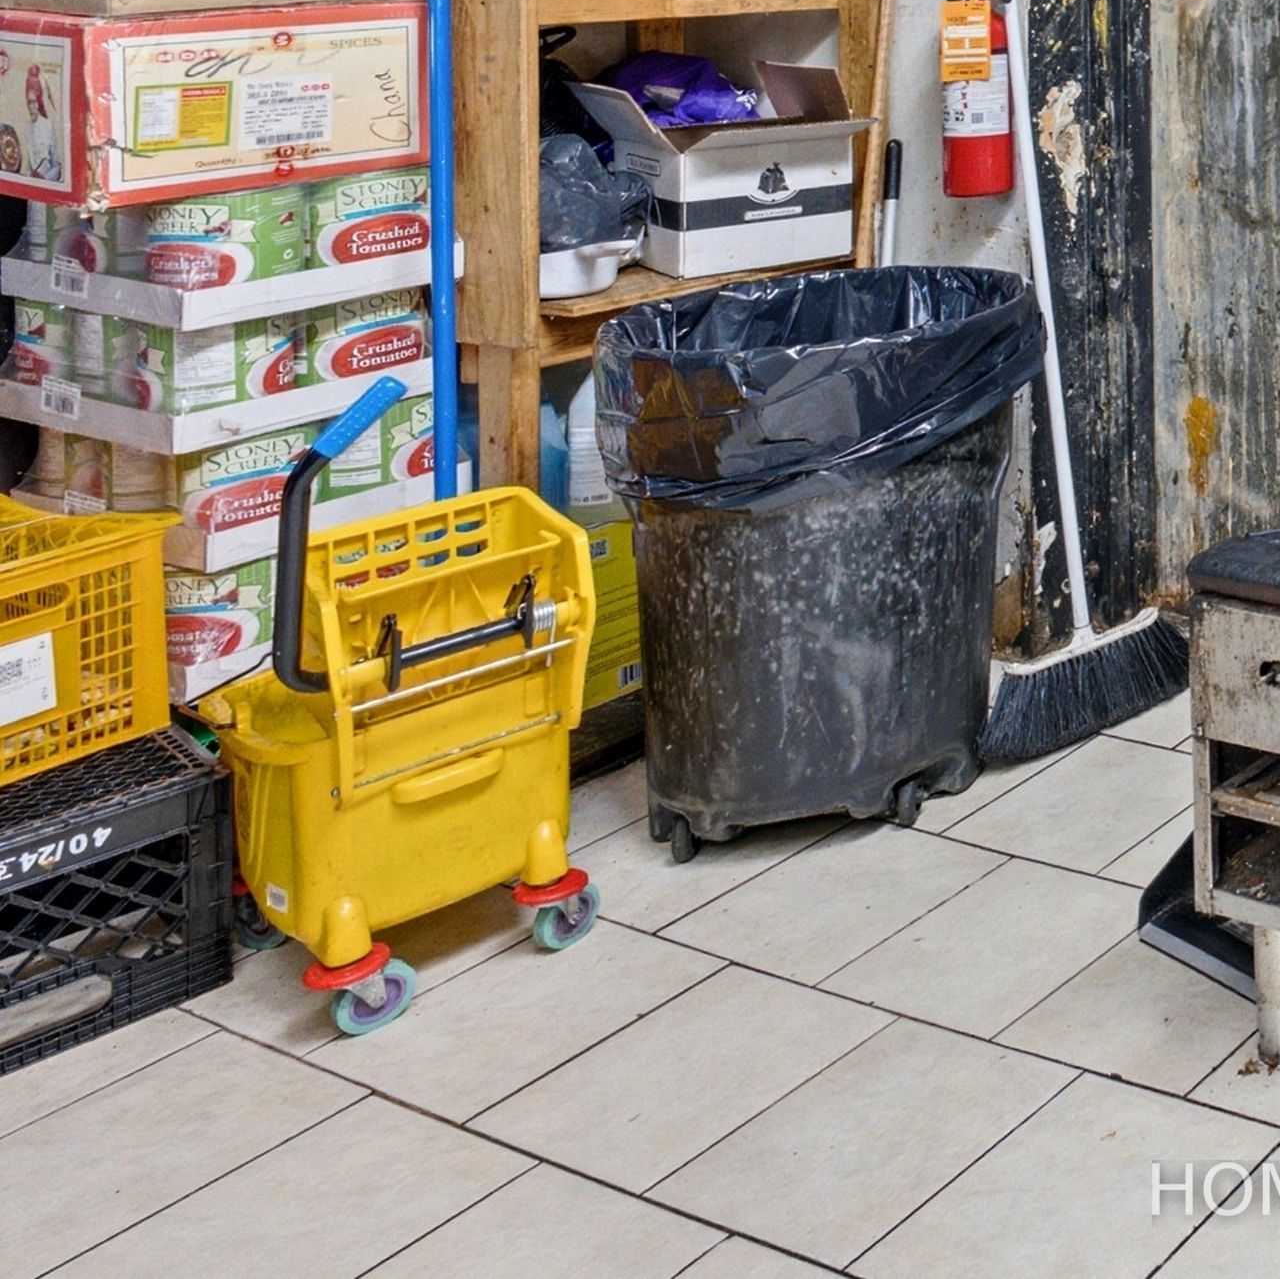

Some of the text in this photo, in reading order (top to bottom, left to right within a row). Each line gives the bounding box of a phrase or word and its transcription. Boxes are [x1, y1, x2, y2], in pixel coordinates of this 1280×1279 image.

[329, 36, 383, 50] SPICES
[340, 177, 424, 208] STONEY
[352, 221, 421, 244] Crushed
[347, 236, 424, 256] Tomatoes
[352, 333, 417, 359] Crushed
[205, 435, 300, 472] STONEY
[217, 488, 283, 515] Crushe
[165, 576, 230, 597] ONEY
